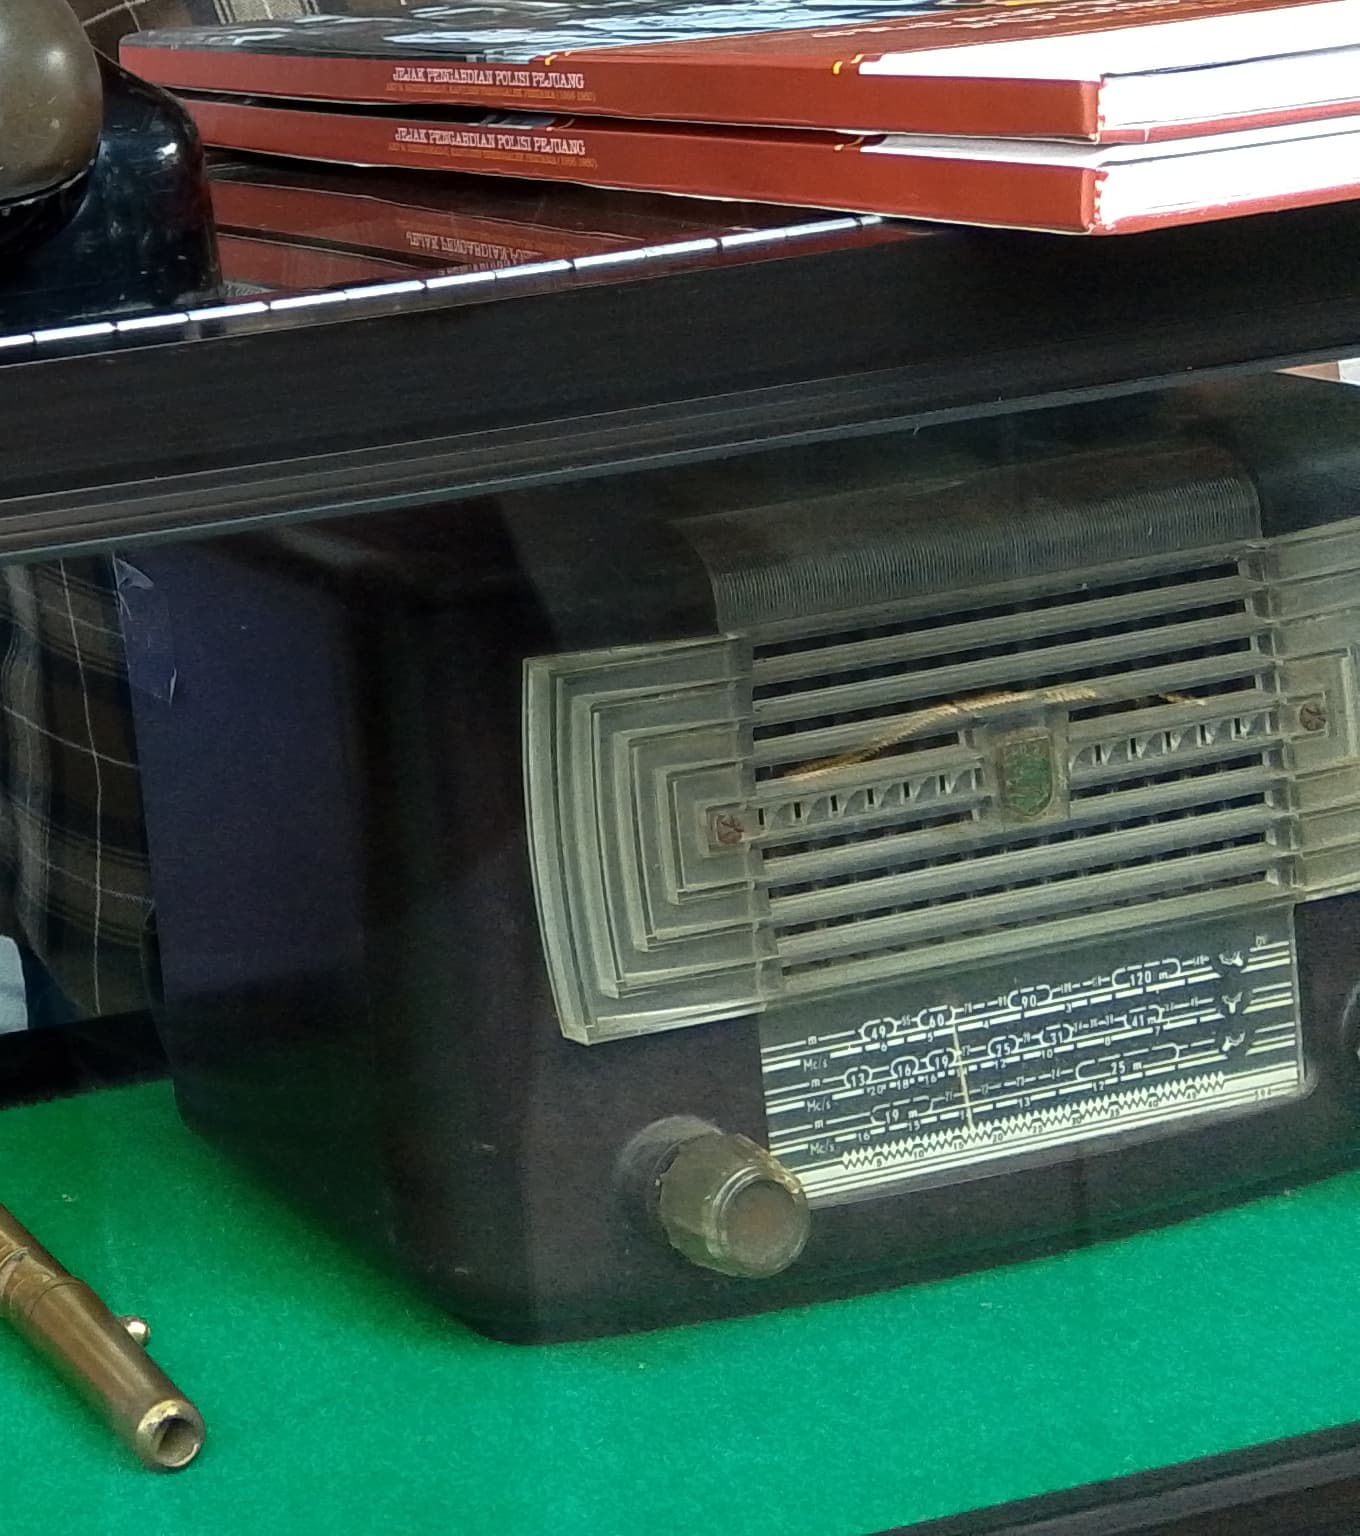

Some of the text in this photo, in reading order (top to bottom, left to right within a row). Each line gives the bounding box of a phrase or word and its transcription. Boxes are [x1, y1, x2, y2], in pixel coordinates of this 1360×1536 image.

[393, 67, 584, 89] JEJAK PENGABDIAN POLISI PEJUANG
[395, 127, 427, 144] JEJAK
[428, 129, 495, 149] PENGABDIAN
[497, 134, 532, 151] POLISI
[534, 136, 585, 155] PEJUANG
[871, 1026, 886, 1041] 49
[930, 1013, 945, 1027] 60
[1021, 994, 1037, 1008] 90
[1130, 970, 1152, 986] 120
[803, 1055, 828, 1073] Mc/s
[880, 1042, 888, 1052] 6
[806, 1096, 831, 1112] Mc/s
[994, 1057, 1006, 1069] 12
[1041, 1046, 1053, 1059] 10
[850, 1073, 865, 1087] 13
[897, 1063, 912, 1078] 16
[934, 1054, 948, 1069] 19
[995, 1043, 1011, 1057] 25
[1049, 1030, 1063, 1044] 31
[1131, 1014, 1144, 1027] 41
[810, 1138, 835, 1155] Mc/s
[857, 1128, 870, 1141] 16
[1018, 1096, 1030, 1109] 13
[1092, 1080, 1104, 1092] 12
[885, 1108, 899, 1124] 19
[1111, 1060, 1126, 1075] 25
